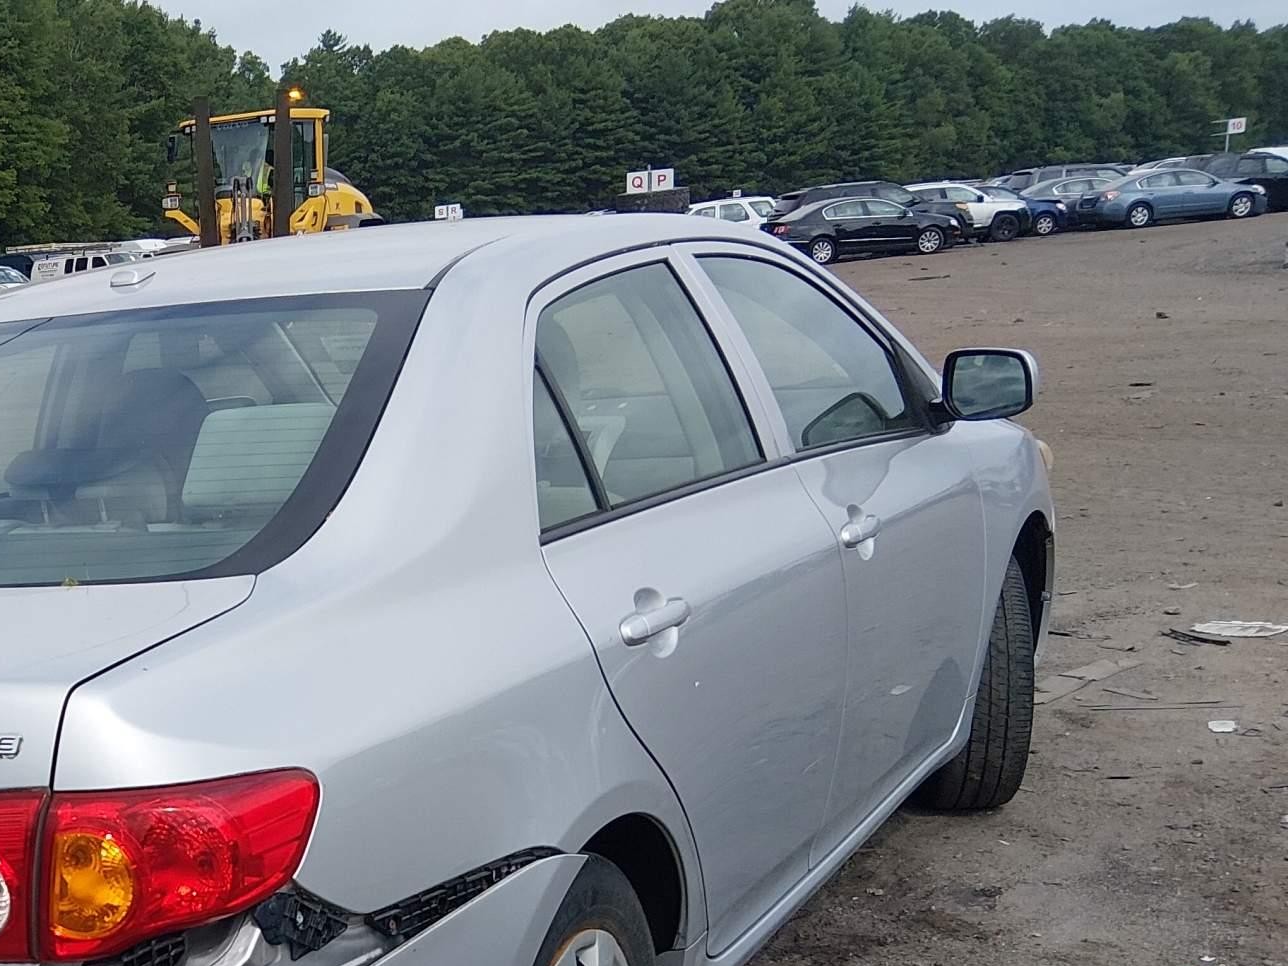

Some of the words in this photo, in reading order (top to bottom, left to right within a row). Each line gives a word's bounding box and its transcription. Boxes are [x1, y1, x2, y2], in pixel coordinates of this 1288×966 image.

[631, 175, 643, 189] Q
[657, 174, 667, 187] P
[450, 206, 457, 215] R
